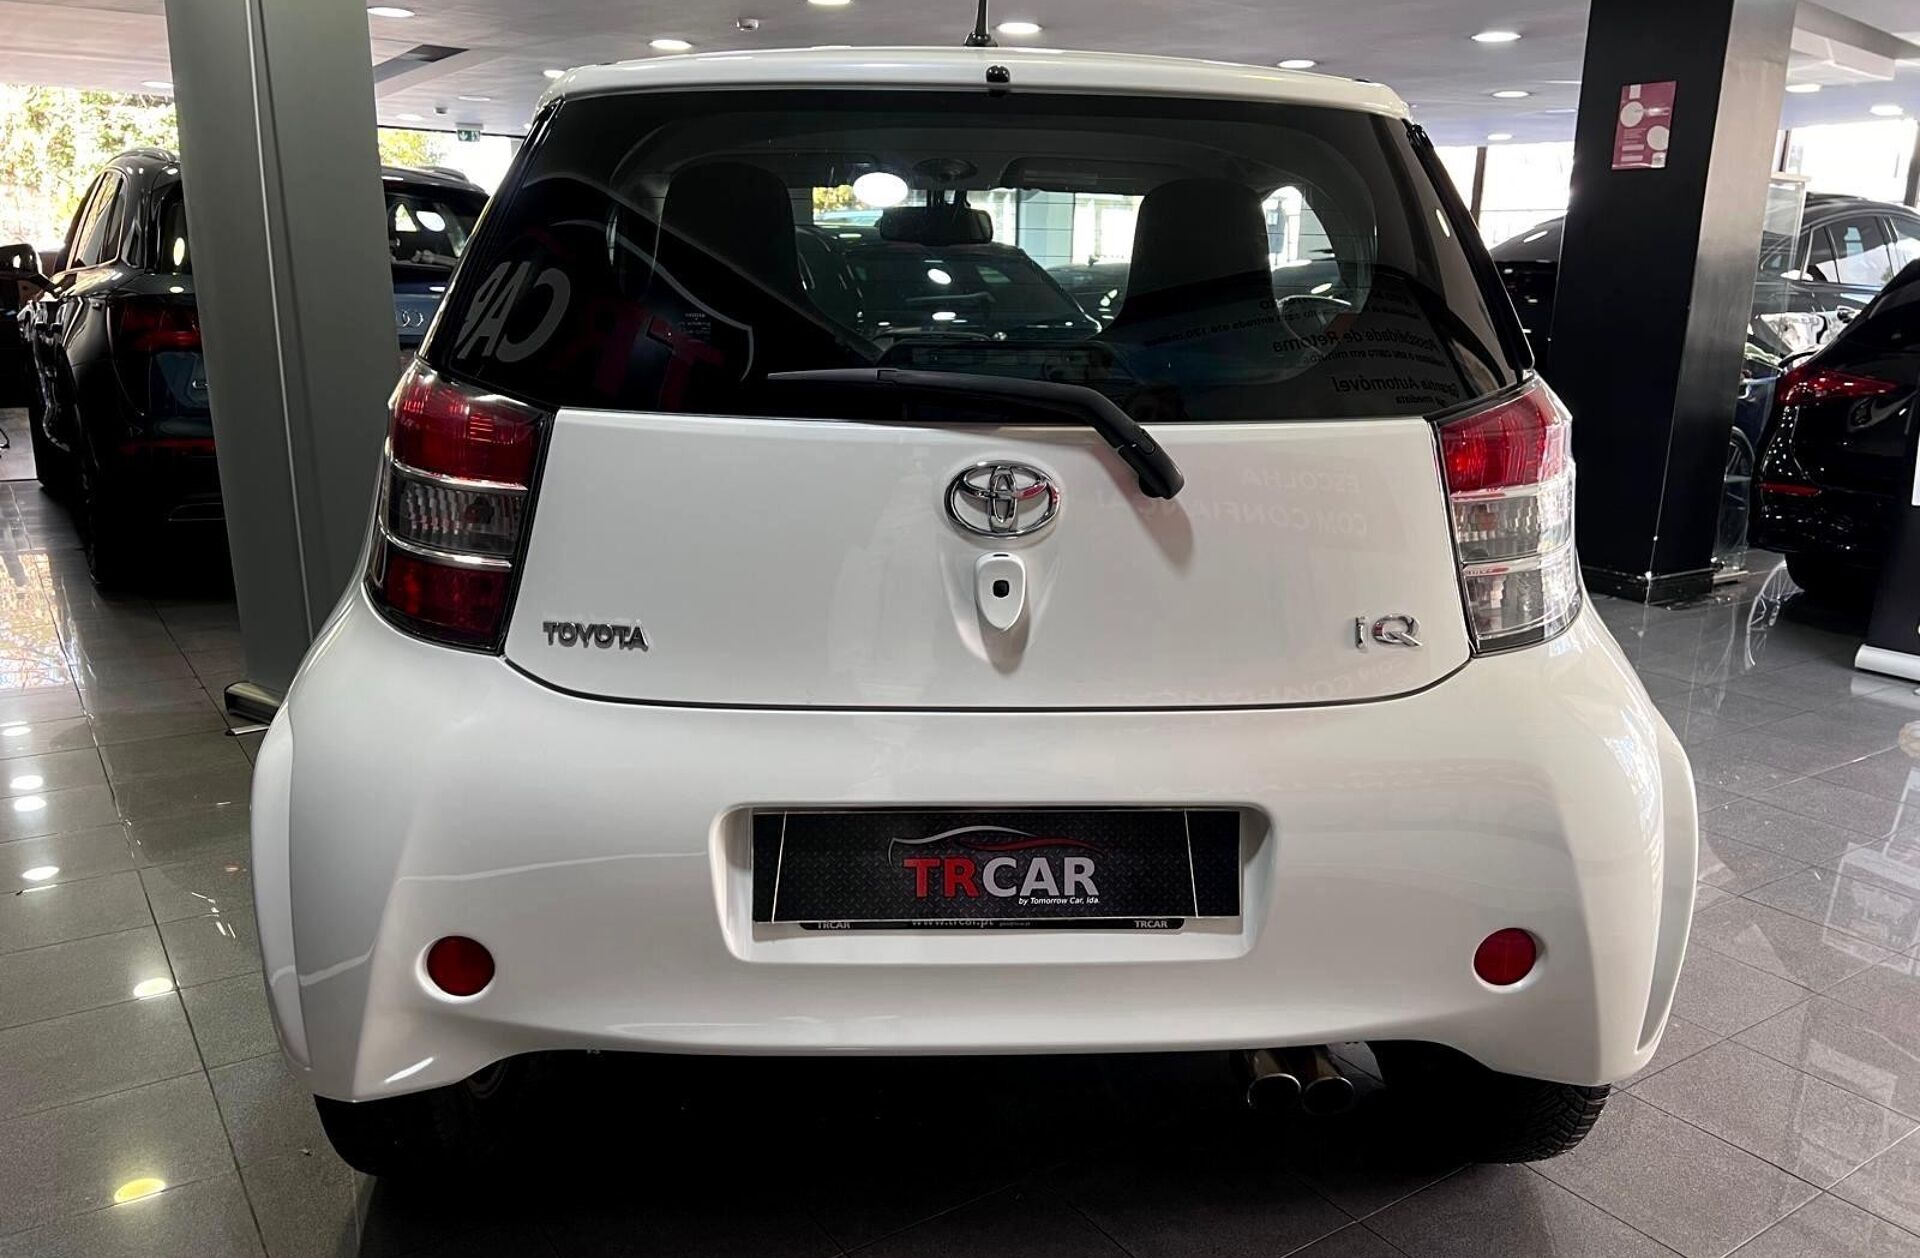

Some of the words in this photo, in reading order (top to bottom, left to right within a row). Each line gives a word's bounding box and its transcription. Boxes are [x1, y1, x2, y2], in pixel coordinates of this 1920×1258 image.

[543, 619, 649, 652] TOYOTA
[903, 856, 1100, 898] TRCAR
[1018, 897, 1029, 906] by
[1030, 896, 1068, 905] Tomorrow
[1134, 919, 1169, 929] TRCAR
